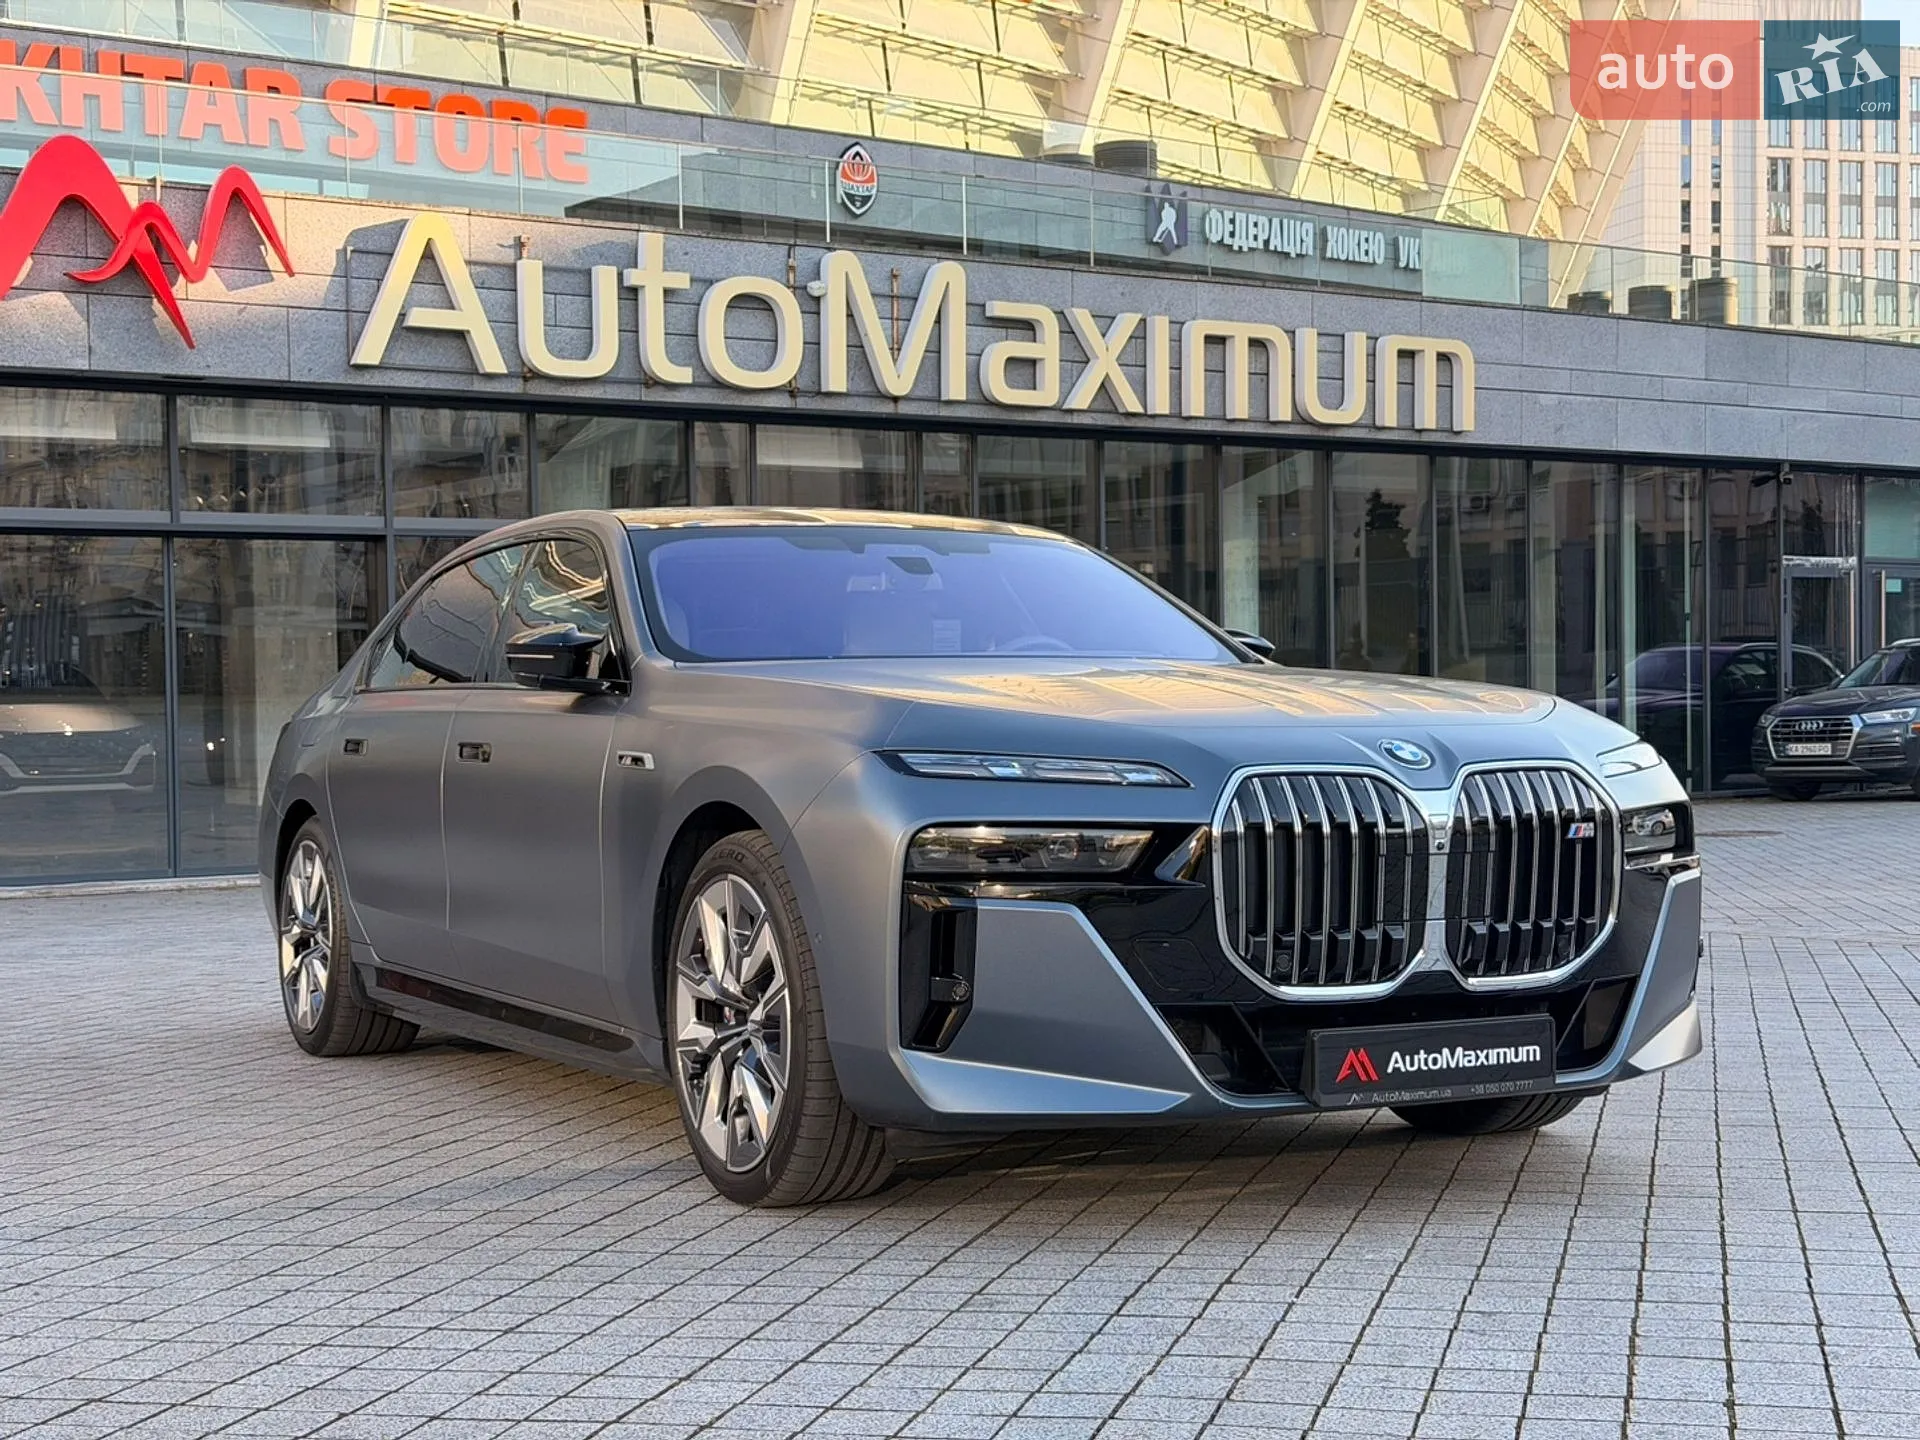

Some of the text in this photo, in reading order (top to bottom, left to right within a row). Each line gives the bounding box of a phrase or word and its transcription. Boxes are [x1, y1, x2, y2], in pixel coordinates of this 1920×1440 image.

[0, 39, 590, 184] KHTAR STORE
[1205, 208, 1314, 258] ФЕДЕРАЦІЯ
[1326, 225, 1385, 265] ХОКЕЮ
[350, 211, 1475, 433] AutoMaximum
[1387, 1045, 1541, 1073] AutoMaximum
